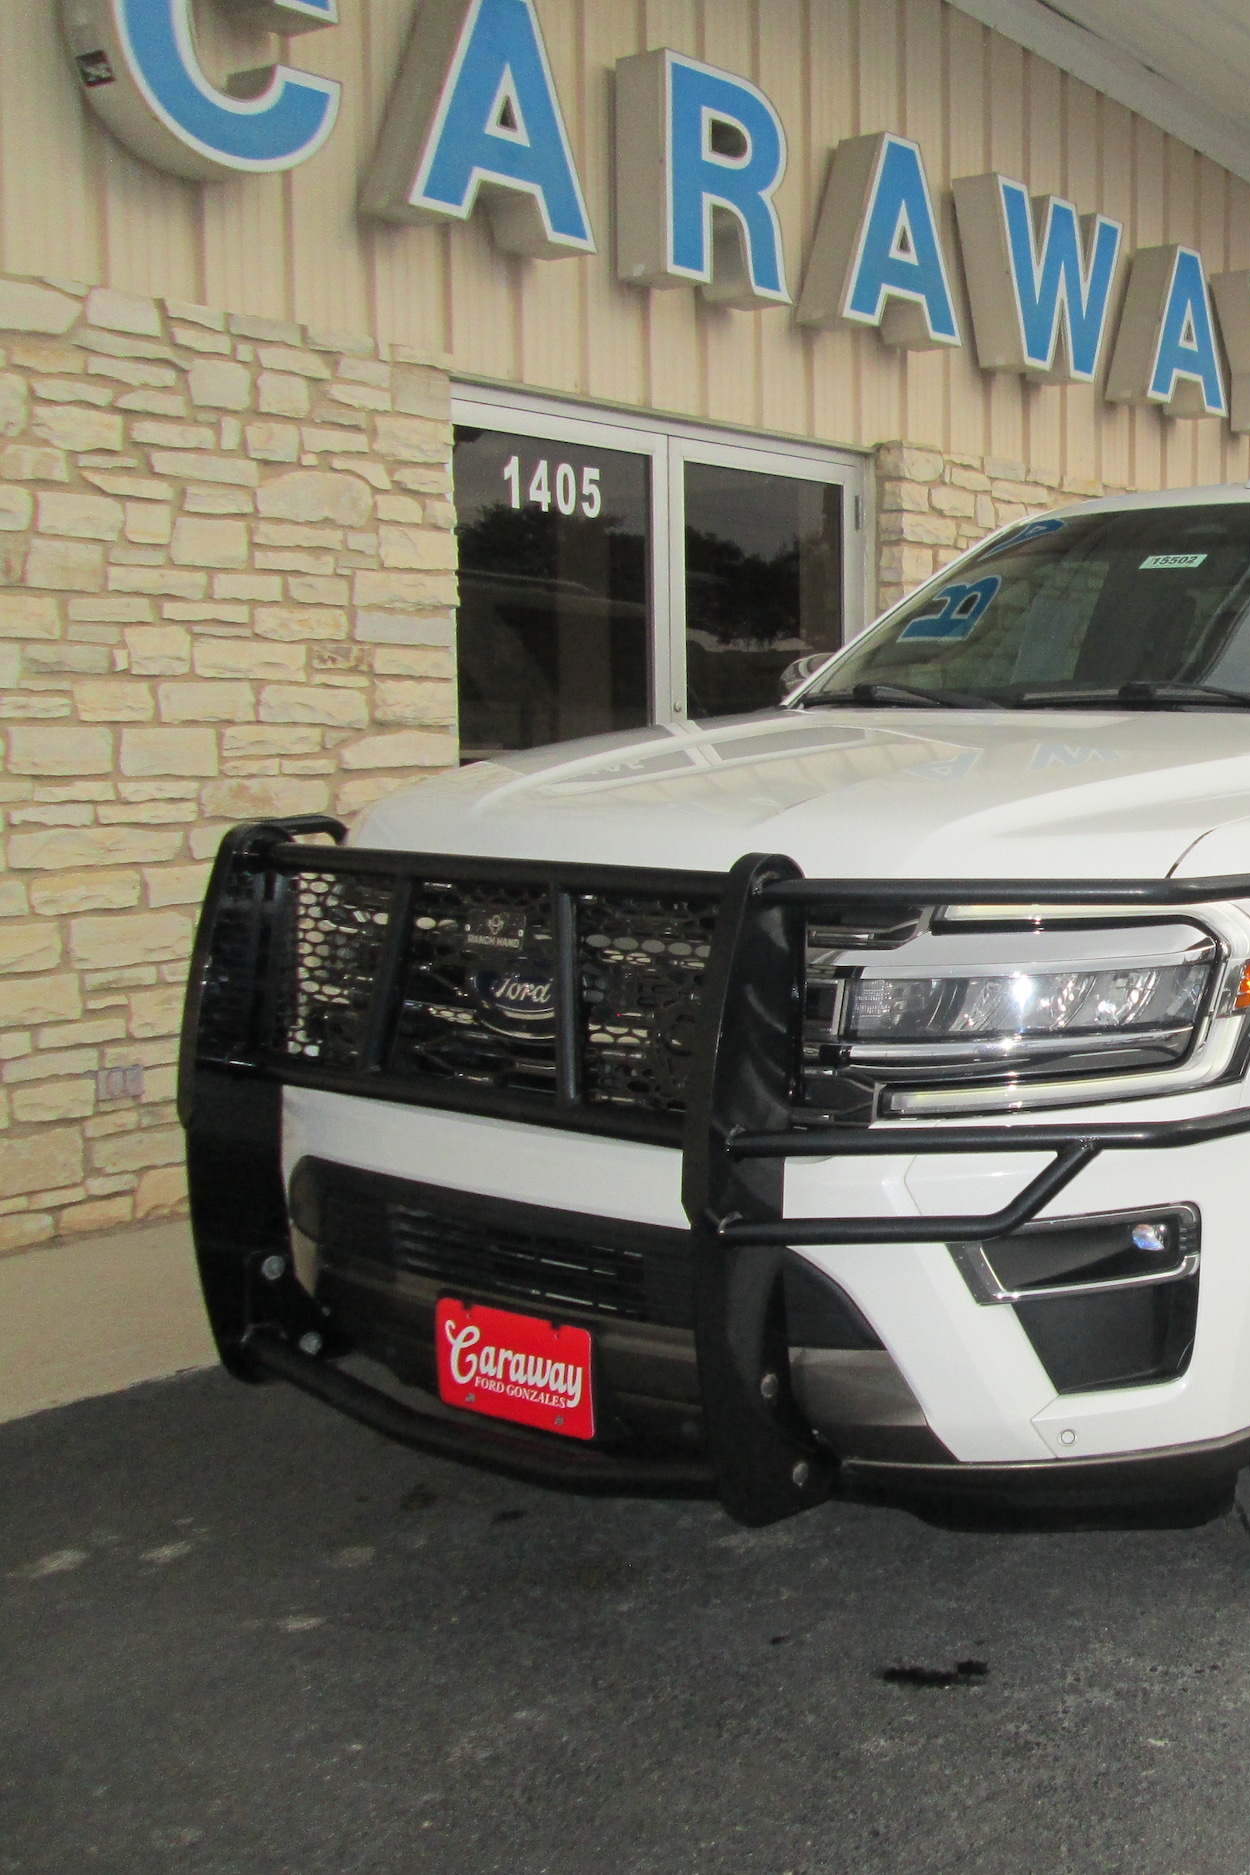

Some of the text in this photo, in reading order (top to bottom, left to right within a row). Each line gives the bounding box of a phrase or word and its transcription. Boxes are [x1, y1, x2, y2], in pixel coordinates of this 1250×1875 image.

[504, 455, 602, 518] 1405
[1151, 555, 1199, 566] 15502
[467, 933, 520, 948] RANCH HAND
[491, 974, 553, 1003] Ford
[444, 1319, 583, 1409] Caraway
[474, 1375, 567, 1409] FORD GONZALES
